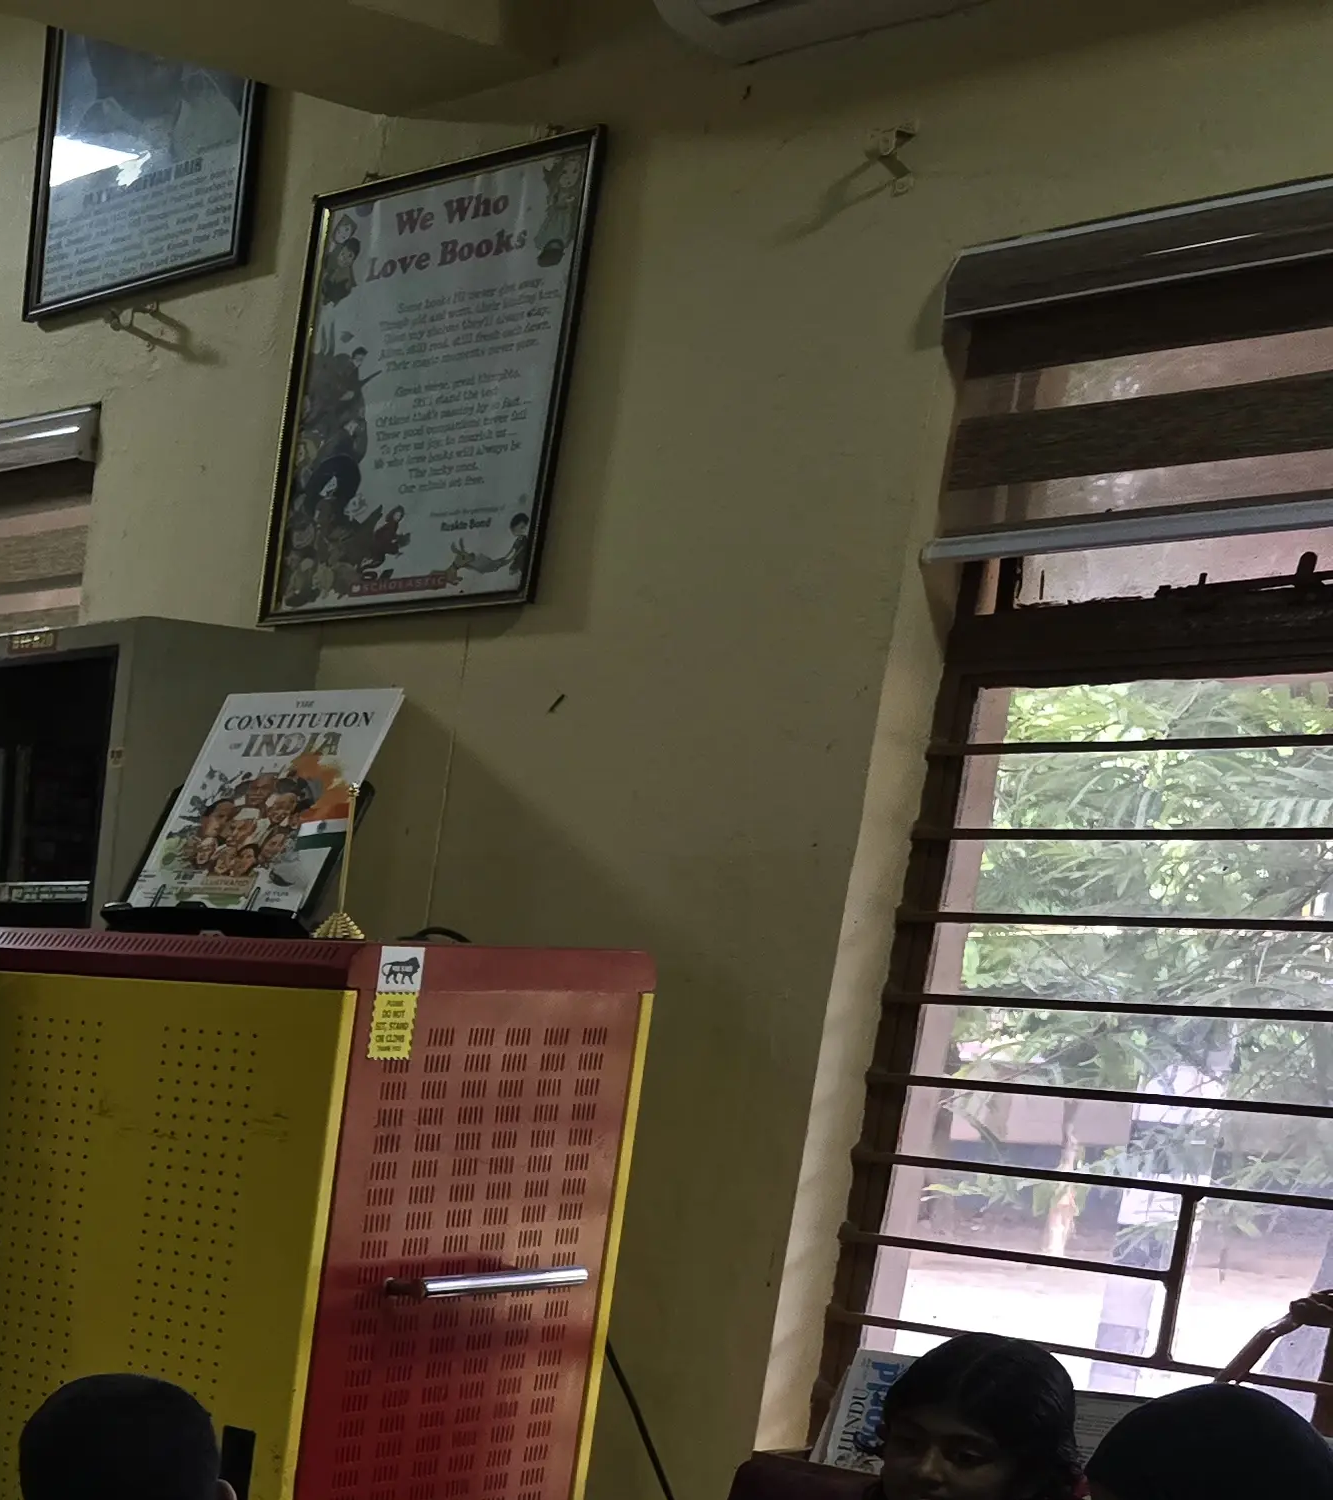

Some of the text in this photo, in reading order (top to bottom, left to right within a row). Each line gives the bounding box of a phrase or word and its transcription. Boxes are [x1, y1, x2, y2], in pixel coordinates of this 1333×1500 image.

[396, 193, 509, 235] We Who
[365, 228, 528, 283] Love Books
[361, 576, 446, 592] SCHOLASTIC
[224, 711, 375, 731] CONSTITUTION
[241, 731, 342, 757] INDIA
